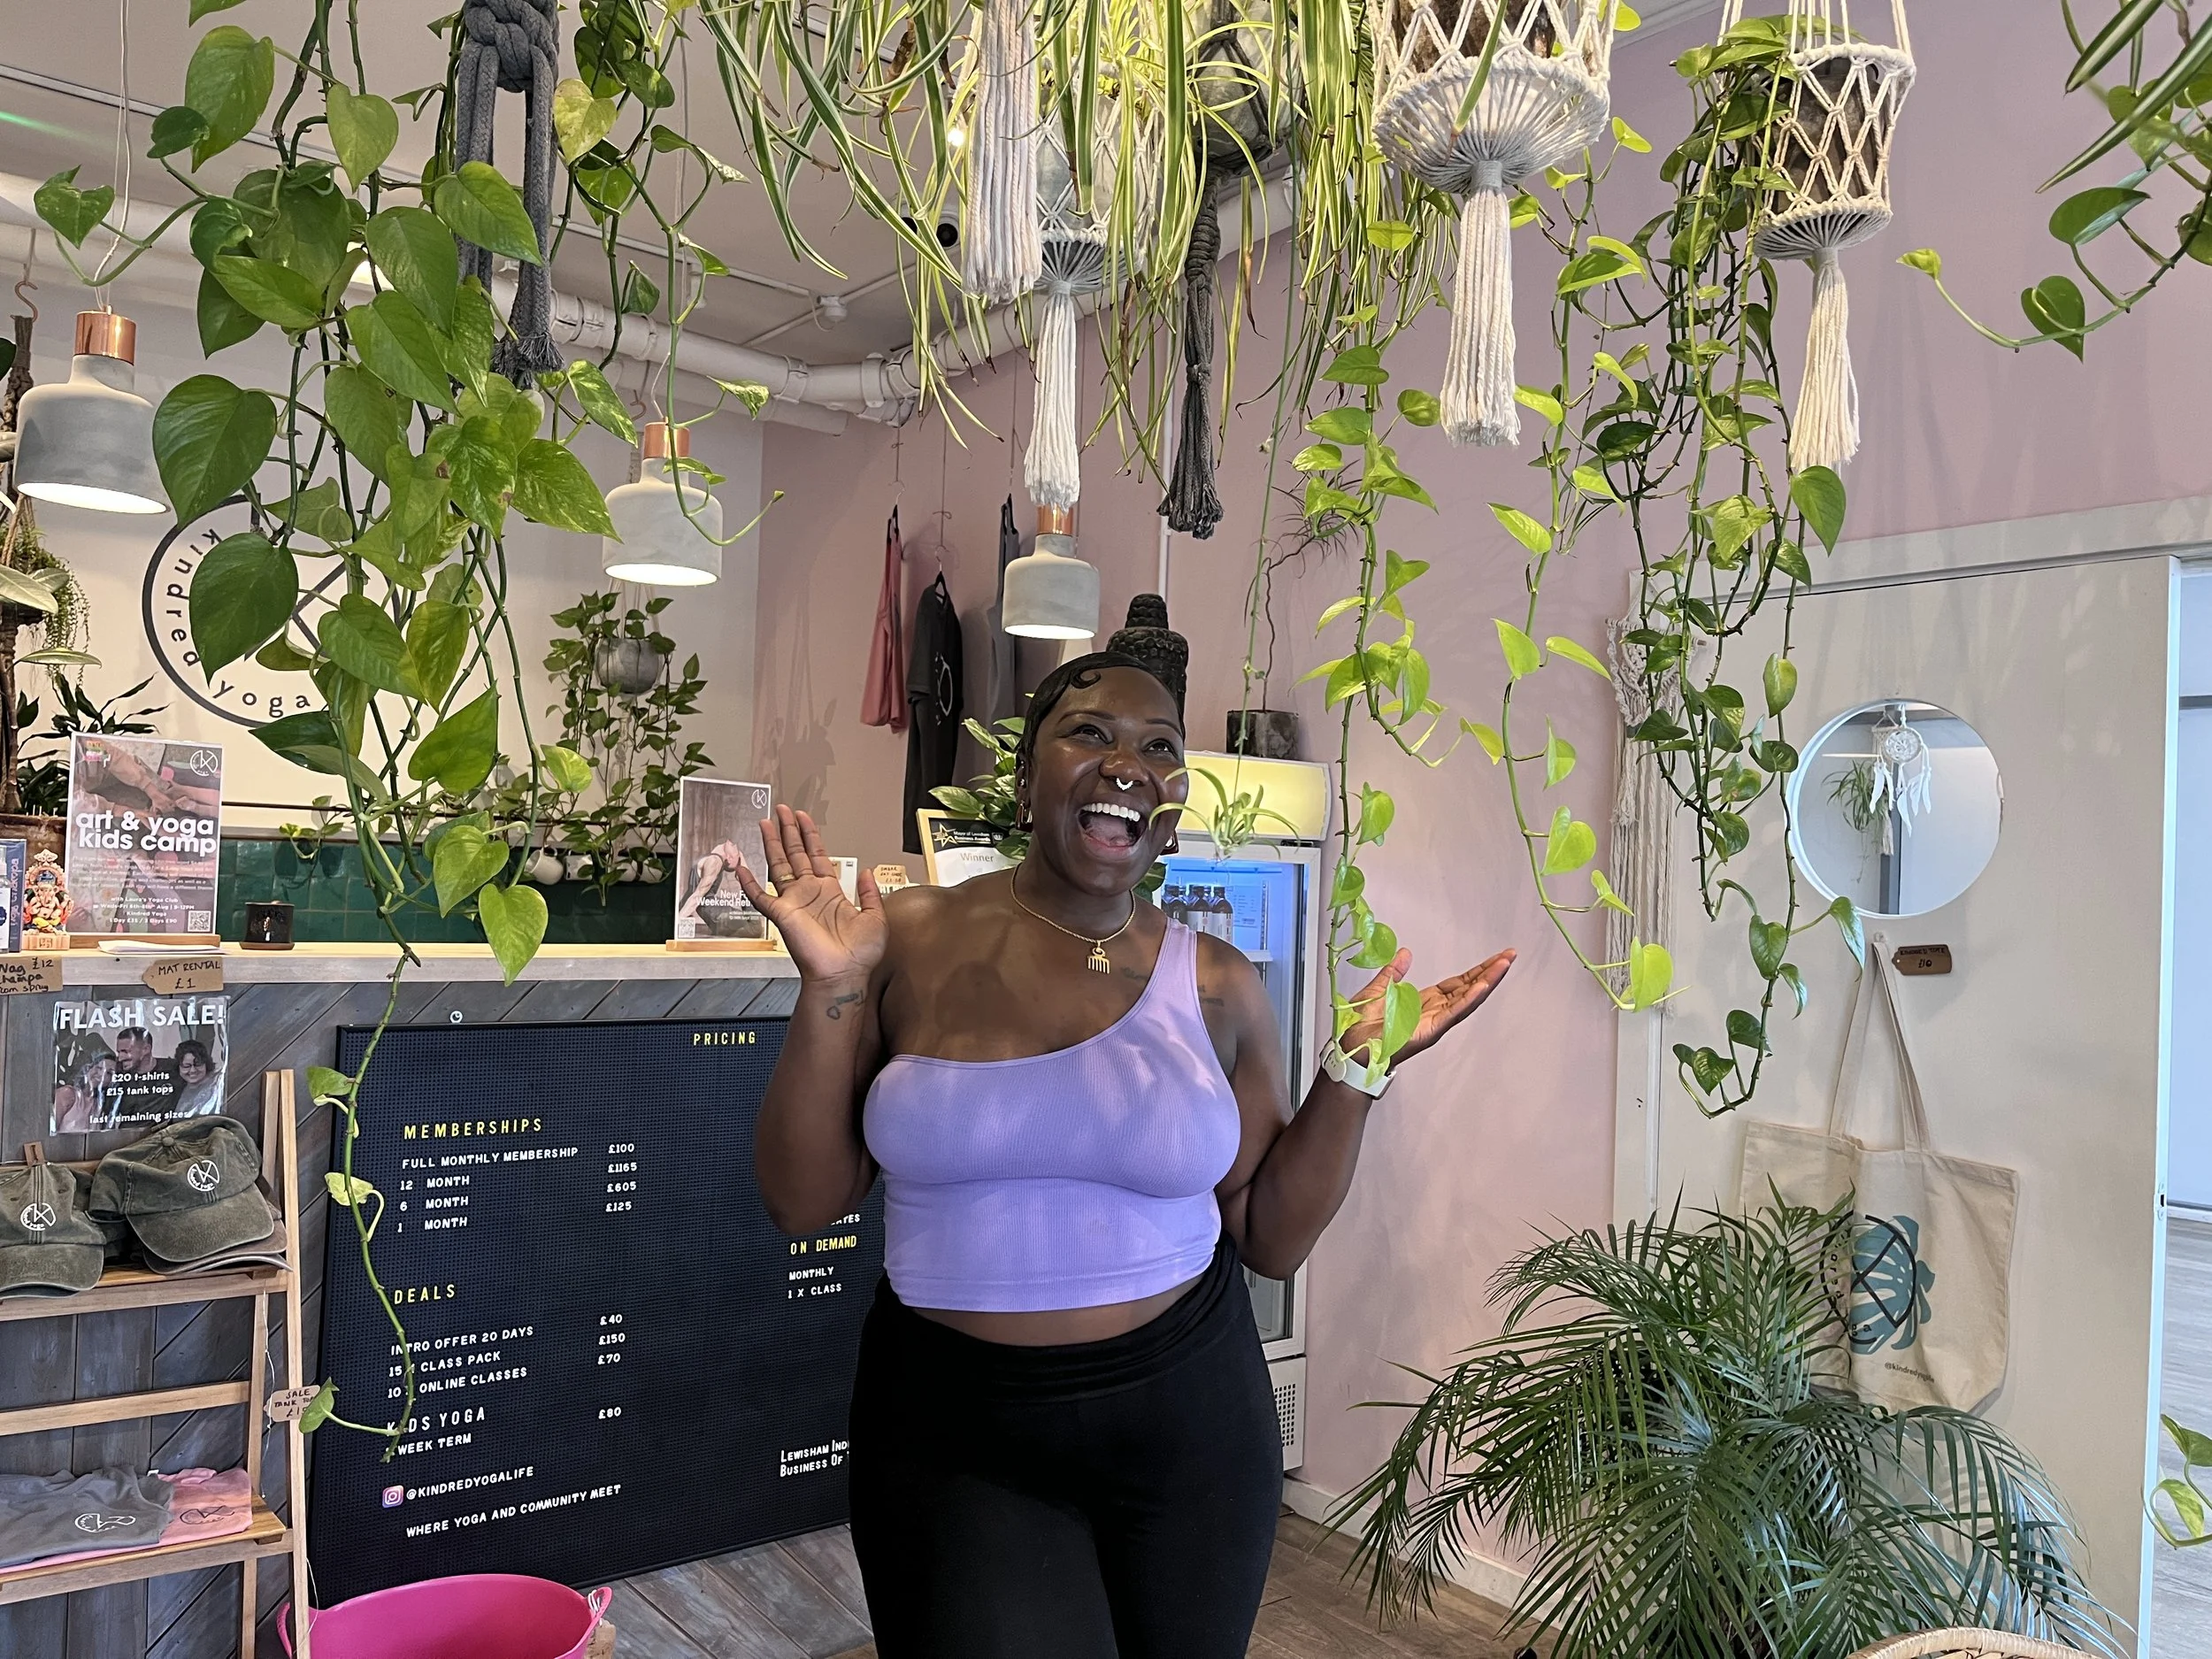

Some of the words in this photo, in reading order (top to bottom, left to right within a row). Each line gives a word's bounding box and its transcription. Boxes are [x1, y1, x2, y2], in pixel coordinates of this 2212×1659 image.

[212, 680, 311, 718] yoga
[75, 810, 114, 830] art
[120, 810, 140, 831] &
[148, 816, 214, 838] yoga
[79, 827, 134, 850] kids
[140, 833, 217, 857] camp
[960, 852, 995, 863] Winner
[695, 897, 734, 907] Weekend
[720, 890, 738, 899] New
[0, 964, 26, 976] Nag
[32, 956, 54, 970] £12
[158, 964, 180, 975] MAT
[183, 960, 220, 972] RENTAL
[0, 974, 44, 986] hampa
[59, 1003, 145, 1030] FLASH
[152, 1004, 225, 1026] SALE!
[694, 1032, 757, 1047] PRICING
[111, 1073, 132, 1083] £20
[134, 1071, 170, 1081] t-shirts
[106, 1087, 124, 1097] £15
[127, 1085, 150, 1095] tank
[152, 1085, 174, 1096] tops
[89, 1115, 108, 1125] last
[110, 1112, 162, 1123] remaining
[403, 1118, 542, 1141] MEMBERSHIPS
[402, 1156, 436, 1170] FULL
[440, 1152, 501, 1167] MONTHLY
[503, 1147, 579, 1164] MEMBERSHIP
[608, 1142, 635, 1155] £100
[399, 1179, 413, 1192] 12
[426, 1175, 471, 1189] MONTH
[399, 1200, 408, 1211] 6
[425, 1195, 469, 1210] MONTH
[607, 1181, 637, 1193] £605
[396, 1222, 403, 1233] 1
[424, 1217, 468, 1231] MONTH
[606, 1200, 632, 1213] £125
[790, 1240, 807, 1256] ON
[816, 1235, 857, 1252] DEMAND
[788, 1266, 834, 1280] MONTHLY
[394, 1284, 457, 1305] DEALS
[787, 1289, 793, 1299] 1
[797, 1287, 804, 1298] X
[810, 1283, 842, 1295] CLASS
[390, 1340, 430, 1356] INTRO
[434, 1333, 478, 1350] OFFER
[481, 1332, 498, 1343] 20
[502, 1325, 534, 1340] DAYS
[599, 1314, 623, 1326] £40
[388, 1365, 403, 1378] 15
[420, 1356, 463, 1372] CLASS
[467, 1350, 502, 1365] PACK
[598, 1333, 626, 1346] £150
[388, 1386, 402, 1399] 10
[419, 1376, 466, 1394] ONLINE
[470, 1366, 527, 1386] CLASSES
[597, 1353, 621, 1365] £70
[286, 1388, 311, 1399] SALE
[387, 1417, 431, 1436] KDS
[439, 1406, 486, 1427] YOGA
[598, 1407, 622, 1420] £80
[397, 1440, 434, 1455] WEEK
[437, 1433, 472, 1448] TERM
[406, 1466, 534, 1501] @KINDREDYOGALIFE
[406, 1520, 449, 1538] WHERE
[454, 1512, 487, 1528] YOGA
[491, 1506, 517, 1520] AND
[519, 1491, 587, 1514] COMMUNITY
[589, 1484, 621, 1501] MEET
